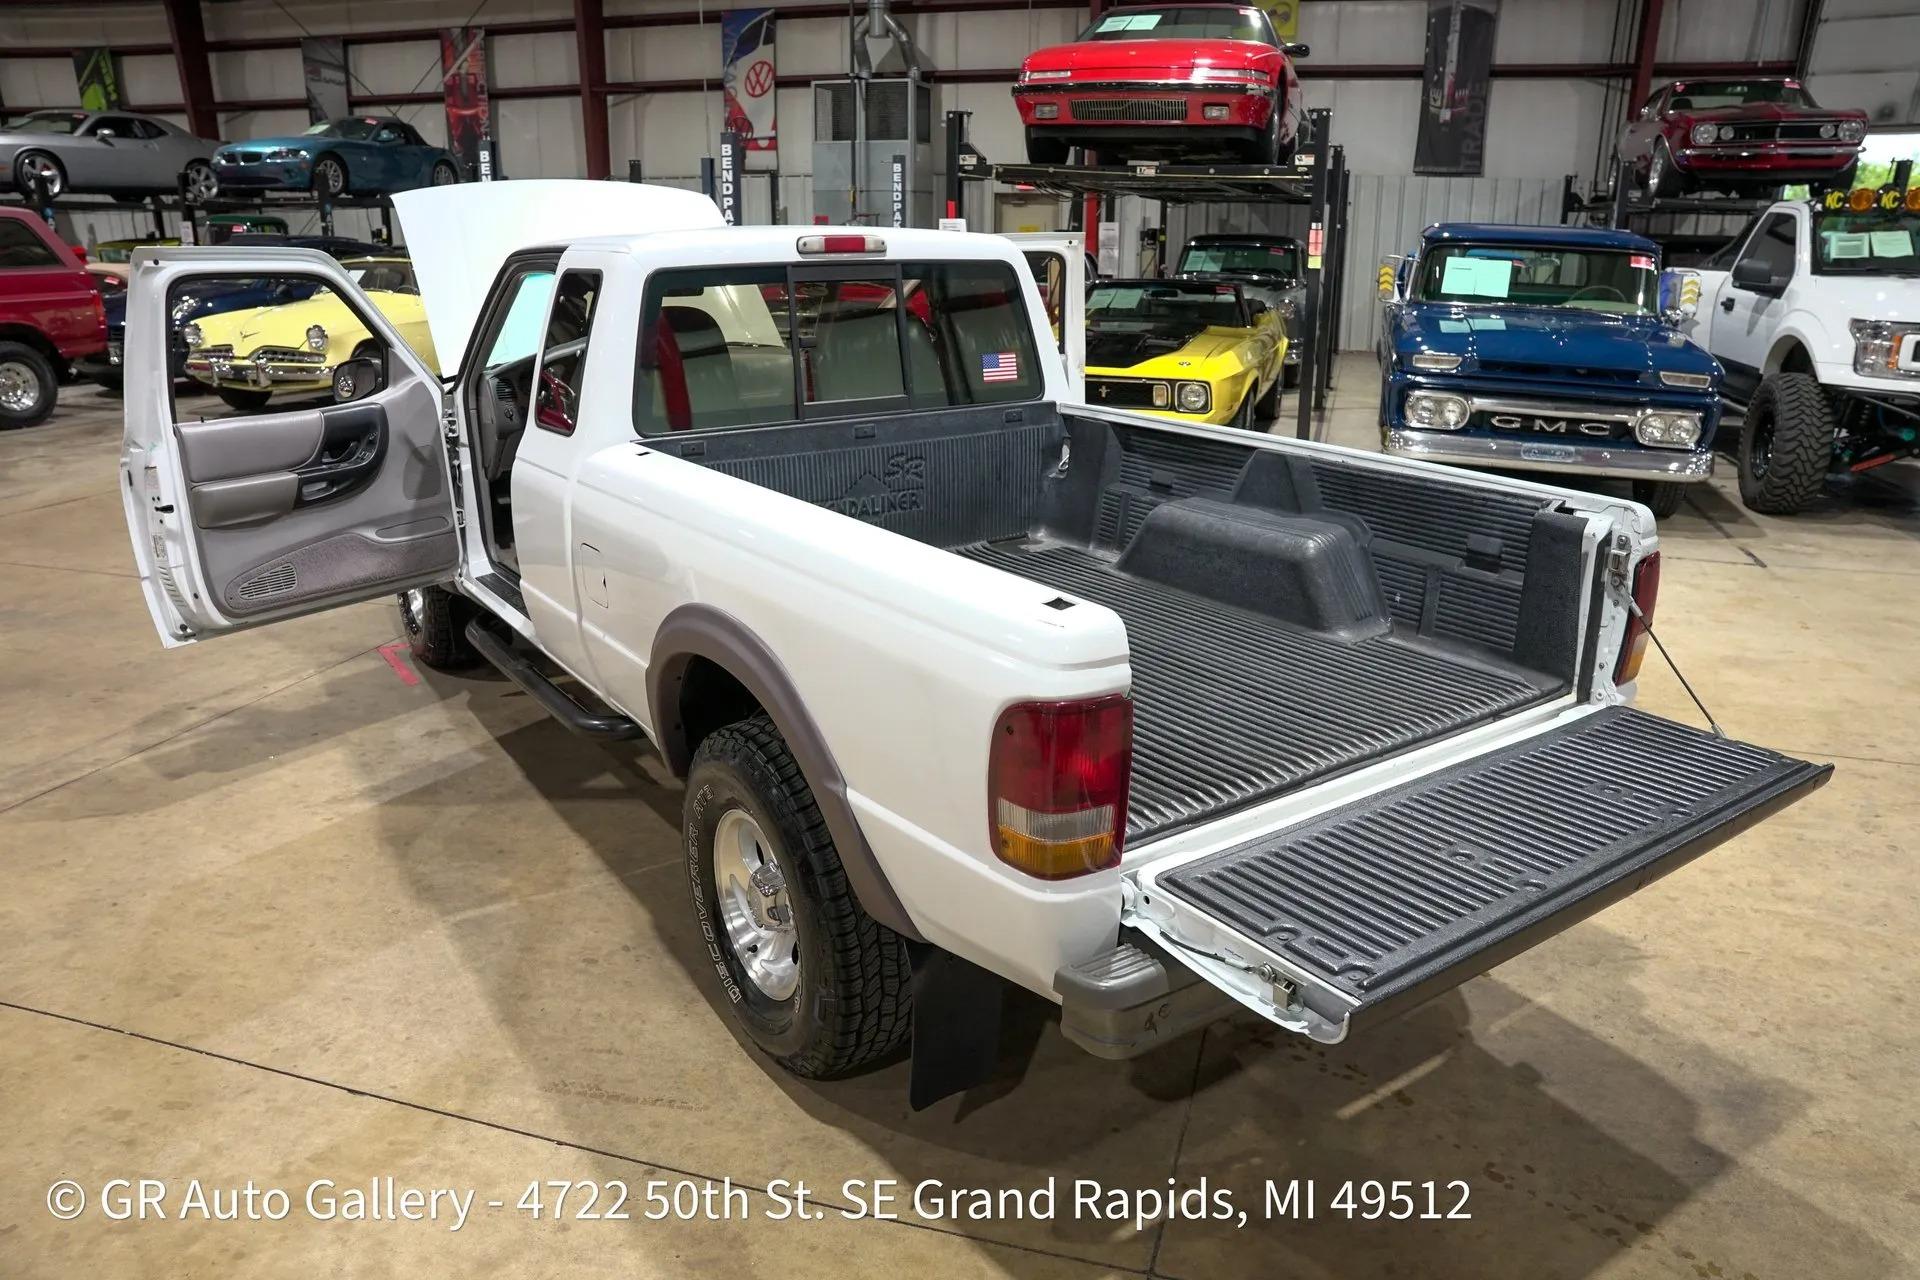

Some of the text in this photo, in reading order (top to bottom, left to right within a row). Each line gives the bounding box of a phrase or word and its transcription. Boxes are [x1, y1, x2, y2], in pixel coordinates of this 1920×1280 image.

[1825, 190, 1845, 209] KC
[1880, 190, 1901, 209] KC
[1489, 414, 1612, 436] GMC
[687, 822, 743, 1004] DISCOVERER
